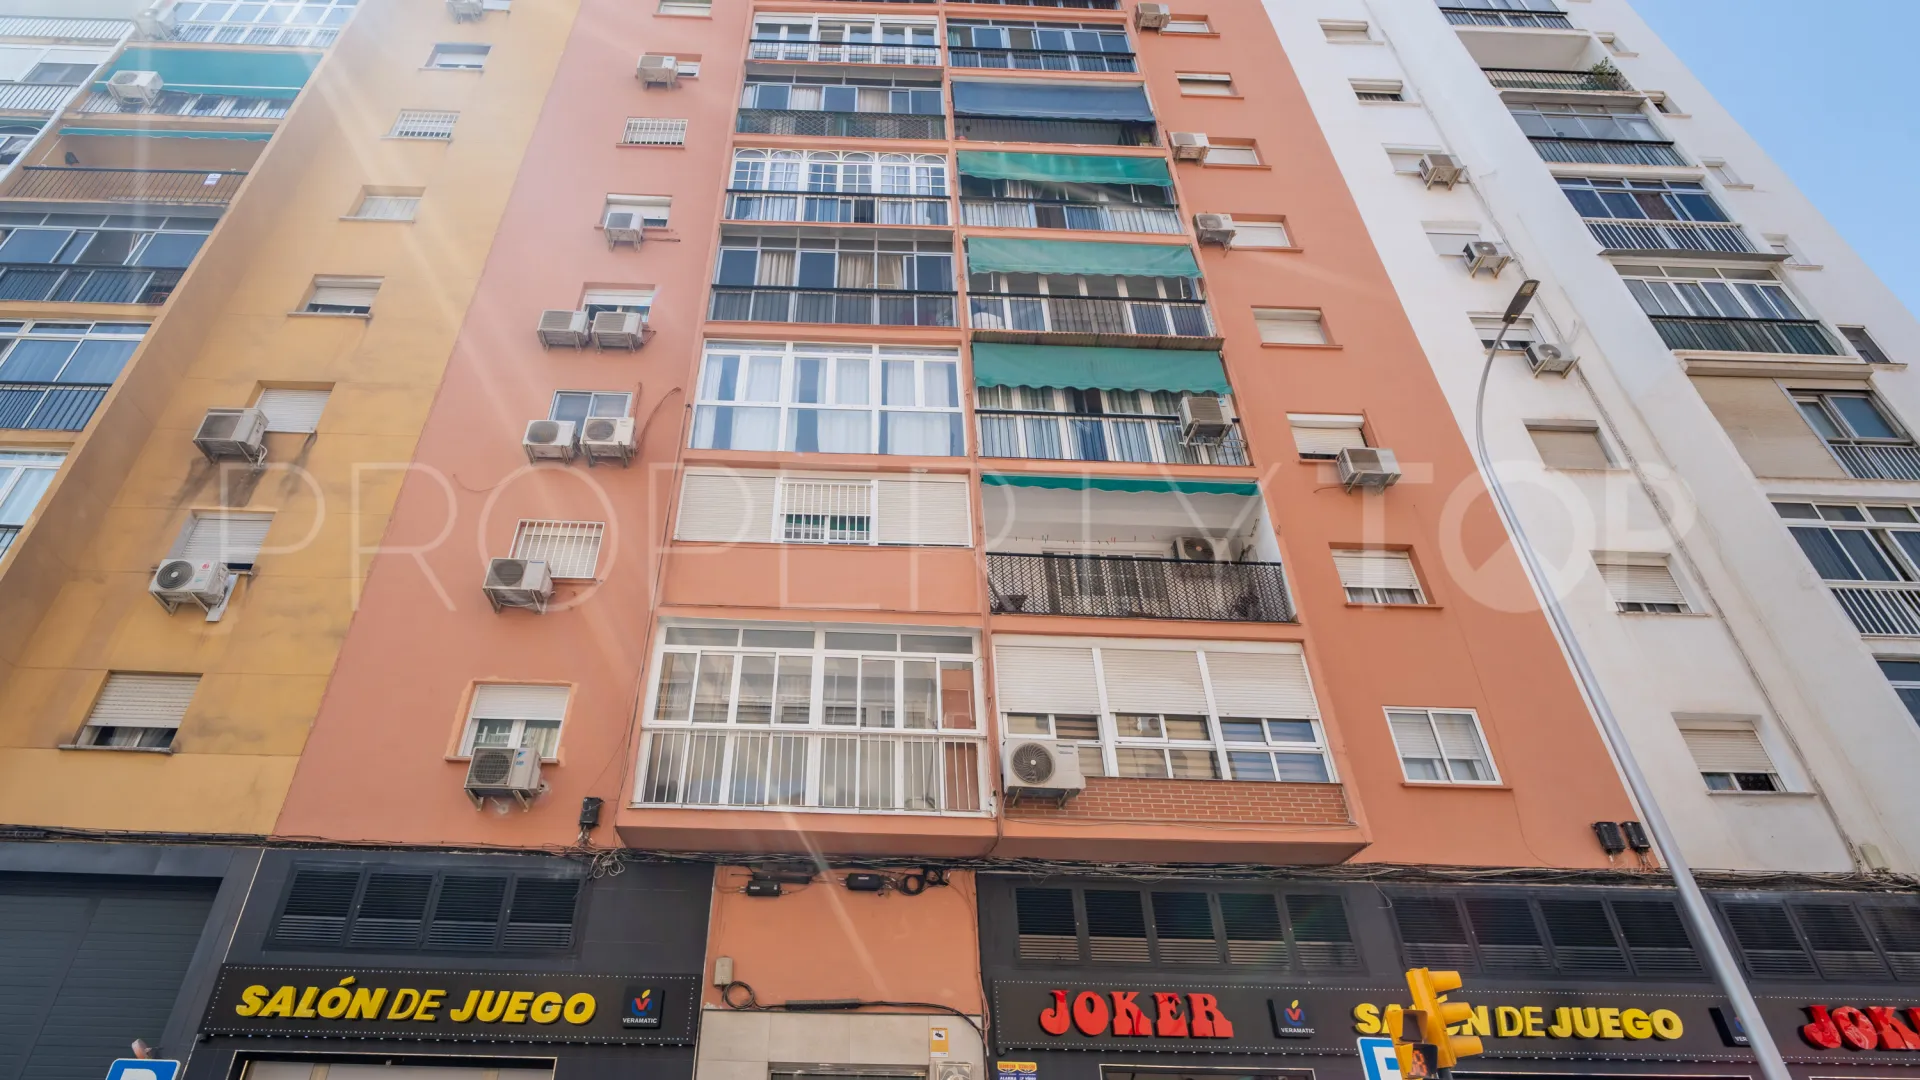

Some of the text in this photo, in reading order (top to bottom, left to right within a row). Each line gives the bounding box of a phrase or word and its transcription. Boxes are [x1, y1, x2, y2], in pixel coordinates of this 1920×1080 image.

[235, 976, 597, 1024] SALÓN DE JUEGO
[1038, 989, 1234, 1038] JOKER
[1496, 1006, 1546, 1037] DE
[1548, 1005, 1684, 1040] JUEGO
[1803, 1004, 1920, 1050] JOK
